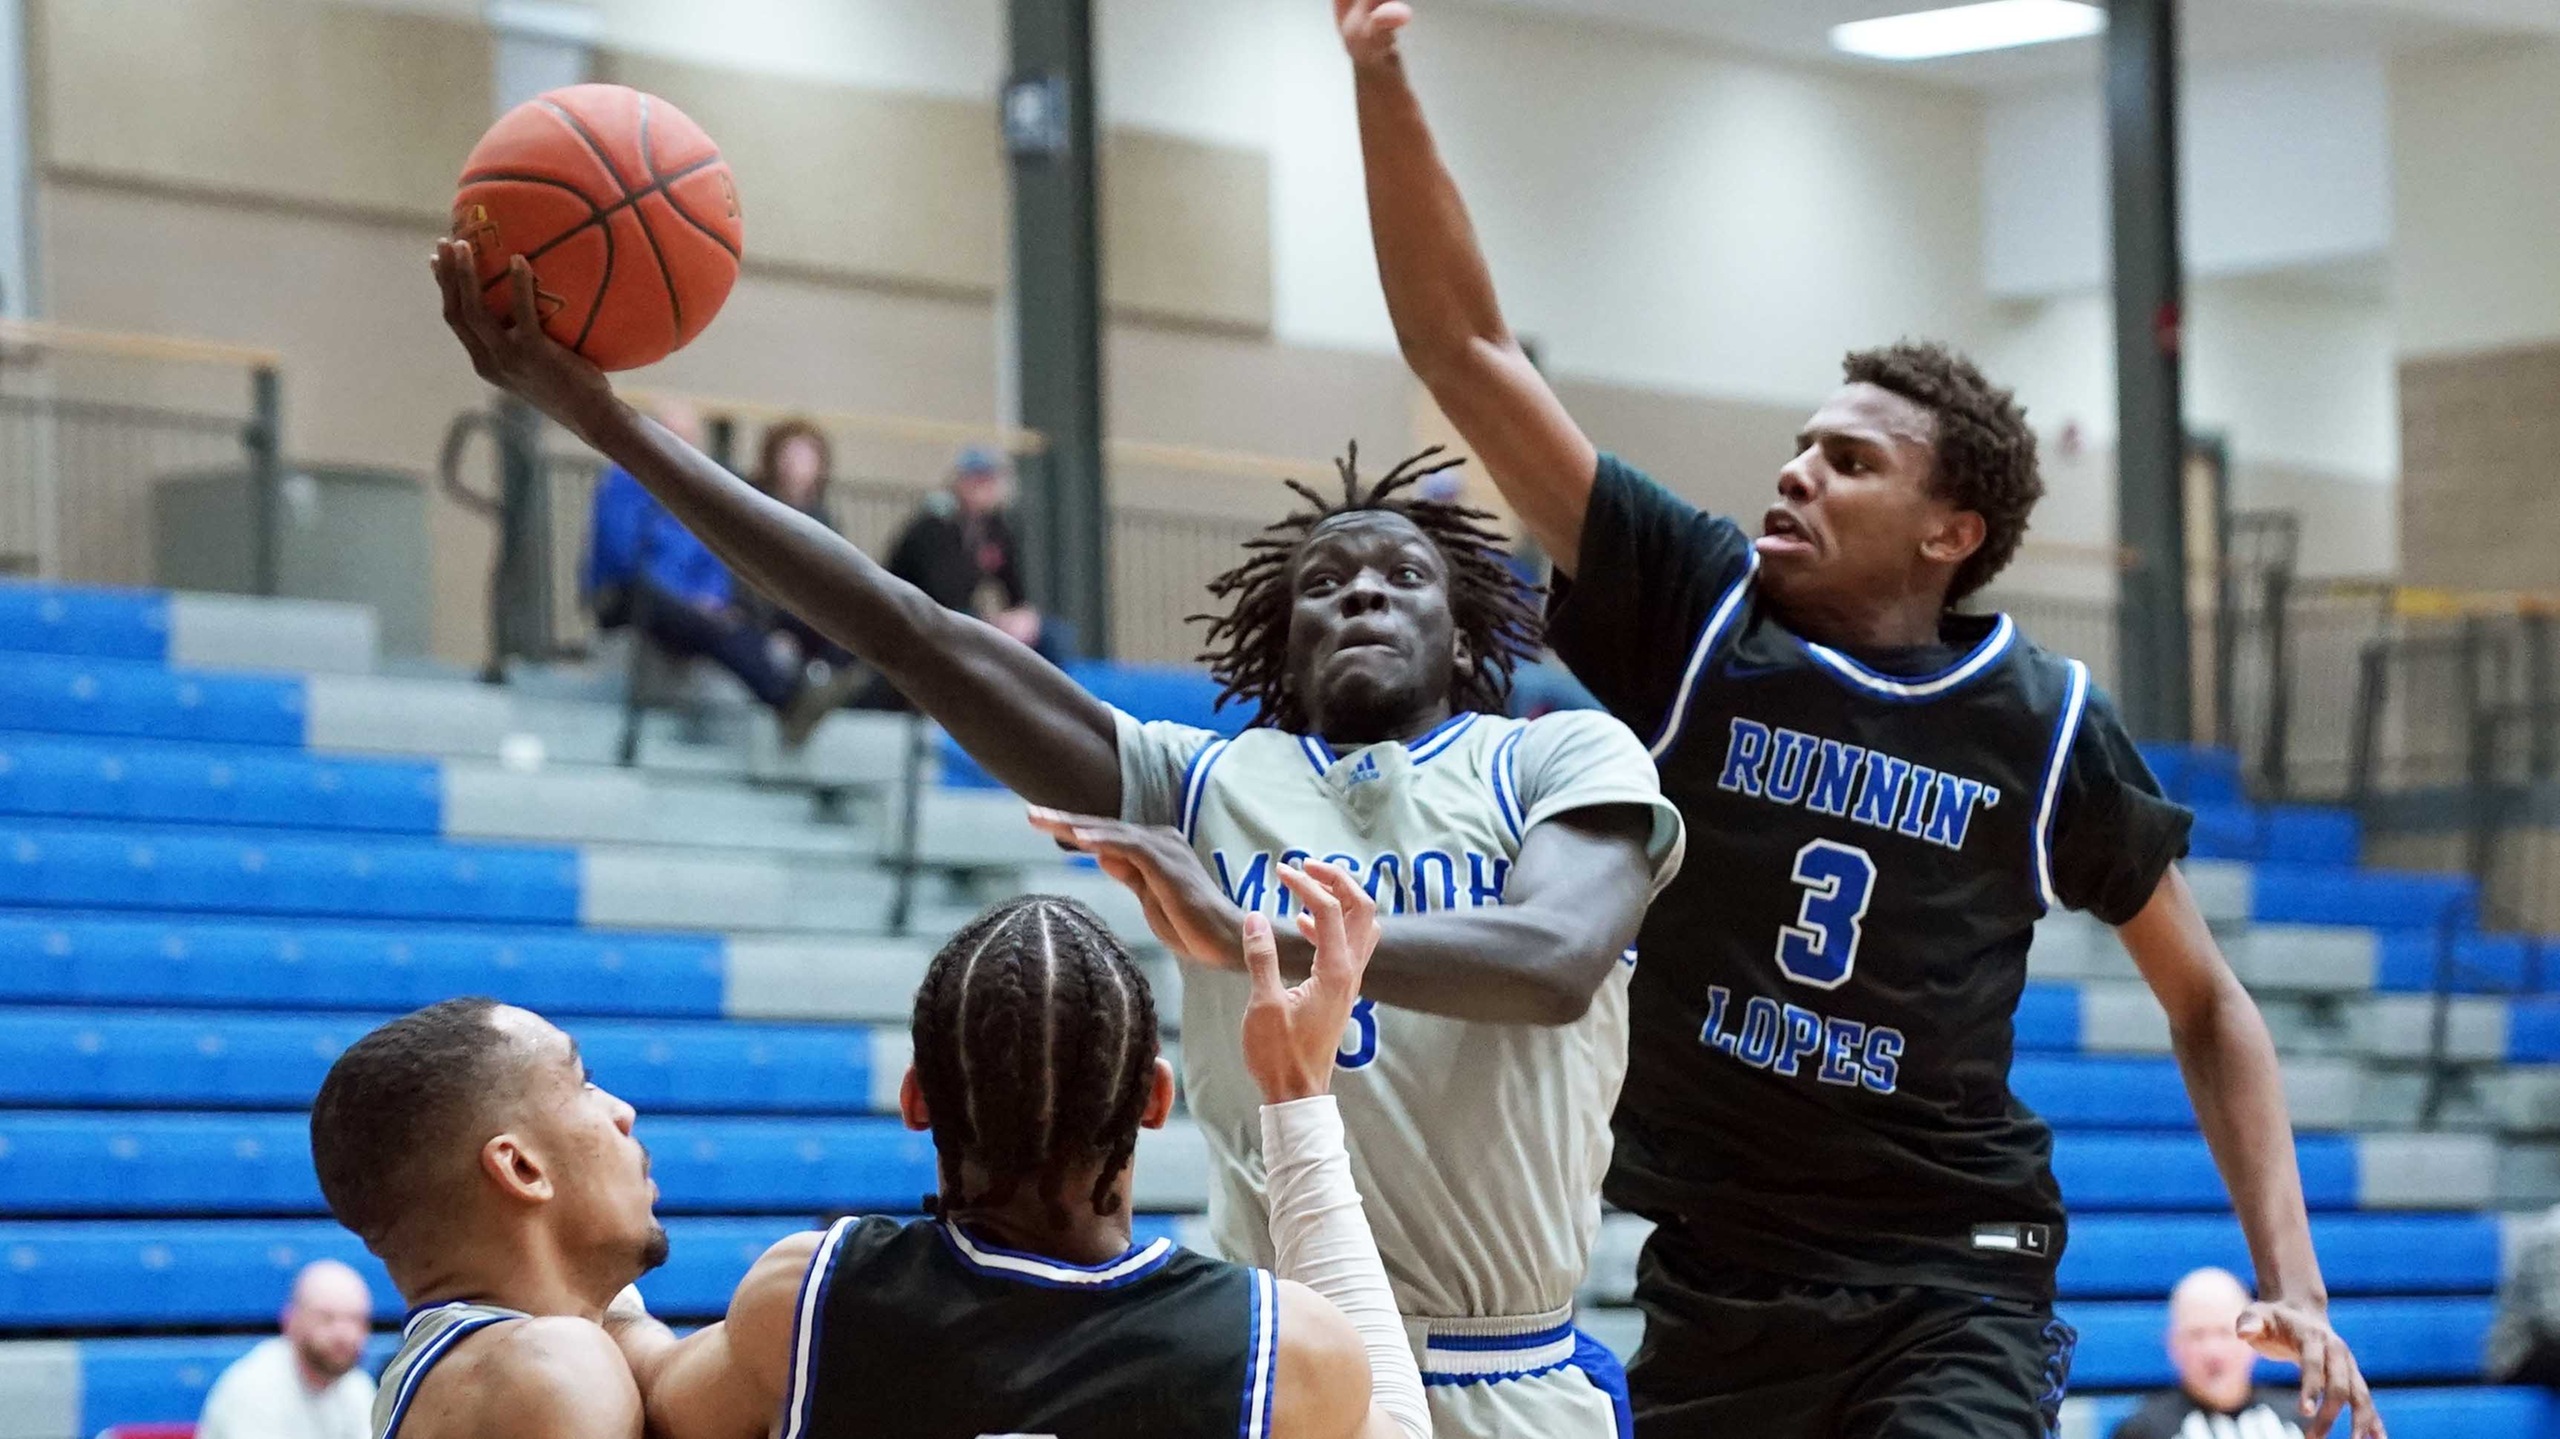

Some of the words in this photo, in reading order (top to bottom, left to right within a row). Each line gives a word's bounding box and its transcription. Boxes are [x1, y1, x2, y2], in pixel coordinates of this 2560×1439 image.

[1718, 717, 1999, 850] RUNNIN'
[1775, 838, 1877, 989] 3
[1700, 986, 1904, 1094] LOPES
[2027, 1231, 2039, 1247] L
